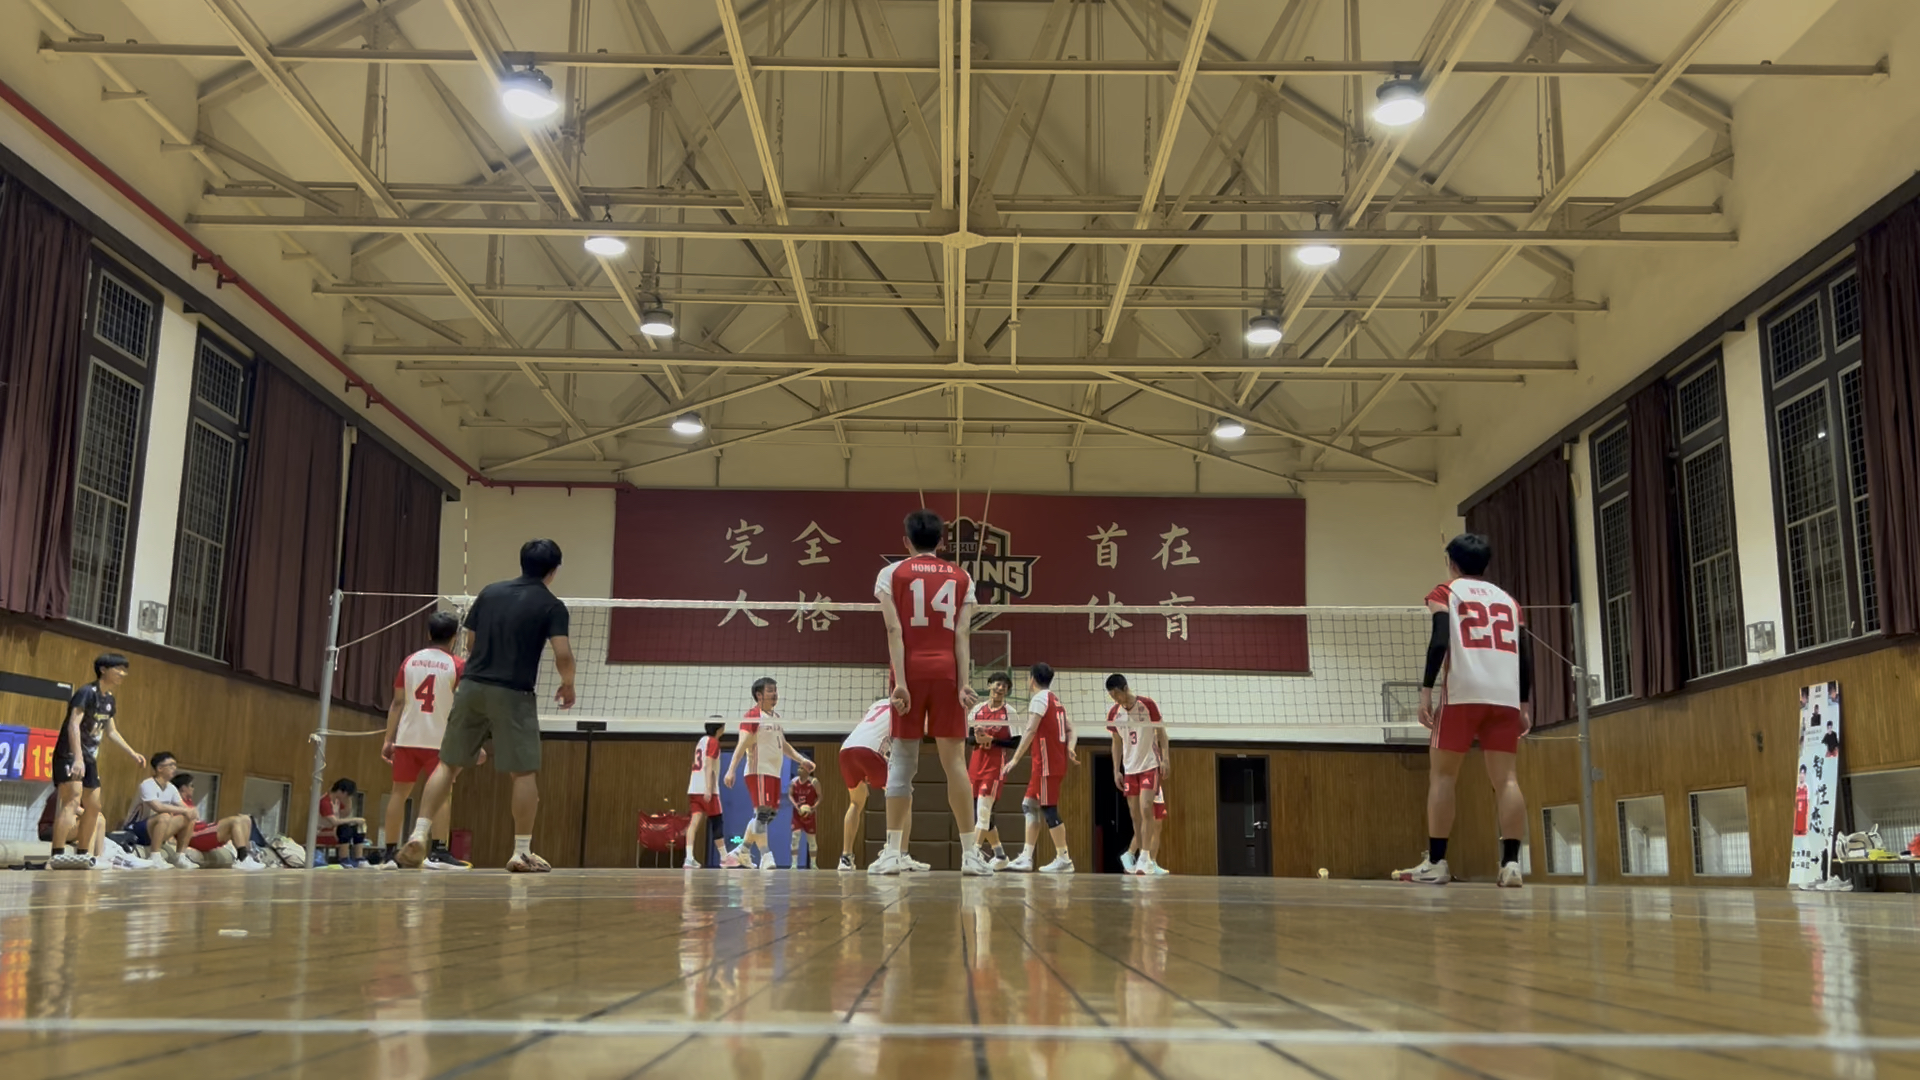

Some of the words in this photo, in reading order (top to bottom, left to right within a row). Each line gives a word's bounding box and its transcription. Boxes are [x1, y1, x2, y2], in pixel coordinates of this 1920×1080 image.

[723, 518, 842, 566] 完全
[1086, 521, 1200, 570] 首在
[717, 589, 841, 633] 人格
[909, 577, 957, 631] 14
[1087, 591, 1196, 640] 体育
[1458, 601, 1517, 654] 22
[414, 673, 436, 713] 4
[0, 741, 25, 777] 24
[32, 744, 55, 778] 15
[1129, 731, 1138, 746] 3
